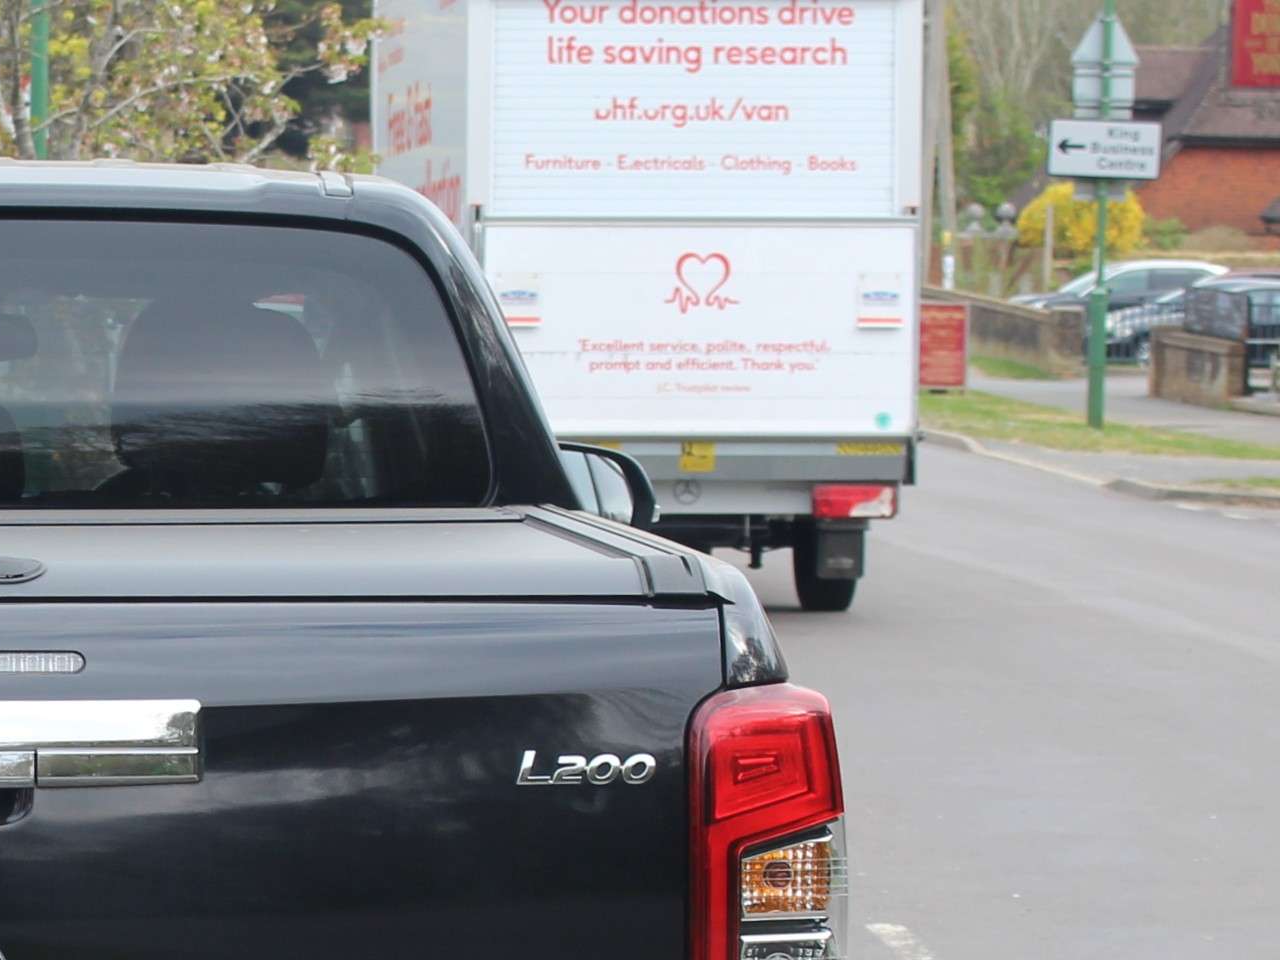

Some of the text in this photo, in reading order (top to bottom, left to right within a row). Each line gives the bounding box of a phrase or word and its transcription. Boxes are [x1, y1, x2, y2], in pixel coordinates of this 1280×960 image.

[542, 0, 855, 25] Your donations drive
[547, 36, 848, 74] life saving research
[1091, 142, 1153, 155] Business
[524, 154, 601, 170] Furniture
[720, 154, 792, 175] Clothing
[807, 154, 856, 171] Books
[1098, 157, 1146, 171] Centre
[589, 359, 642, 374] prompt
[646, 357, 672, 370] and
[741, 358, 784, 370] Thank
[516, 750, 657, 785] L200
